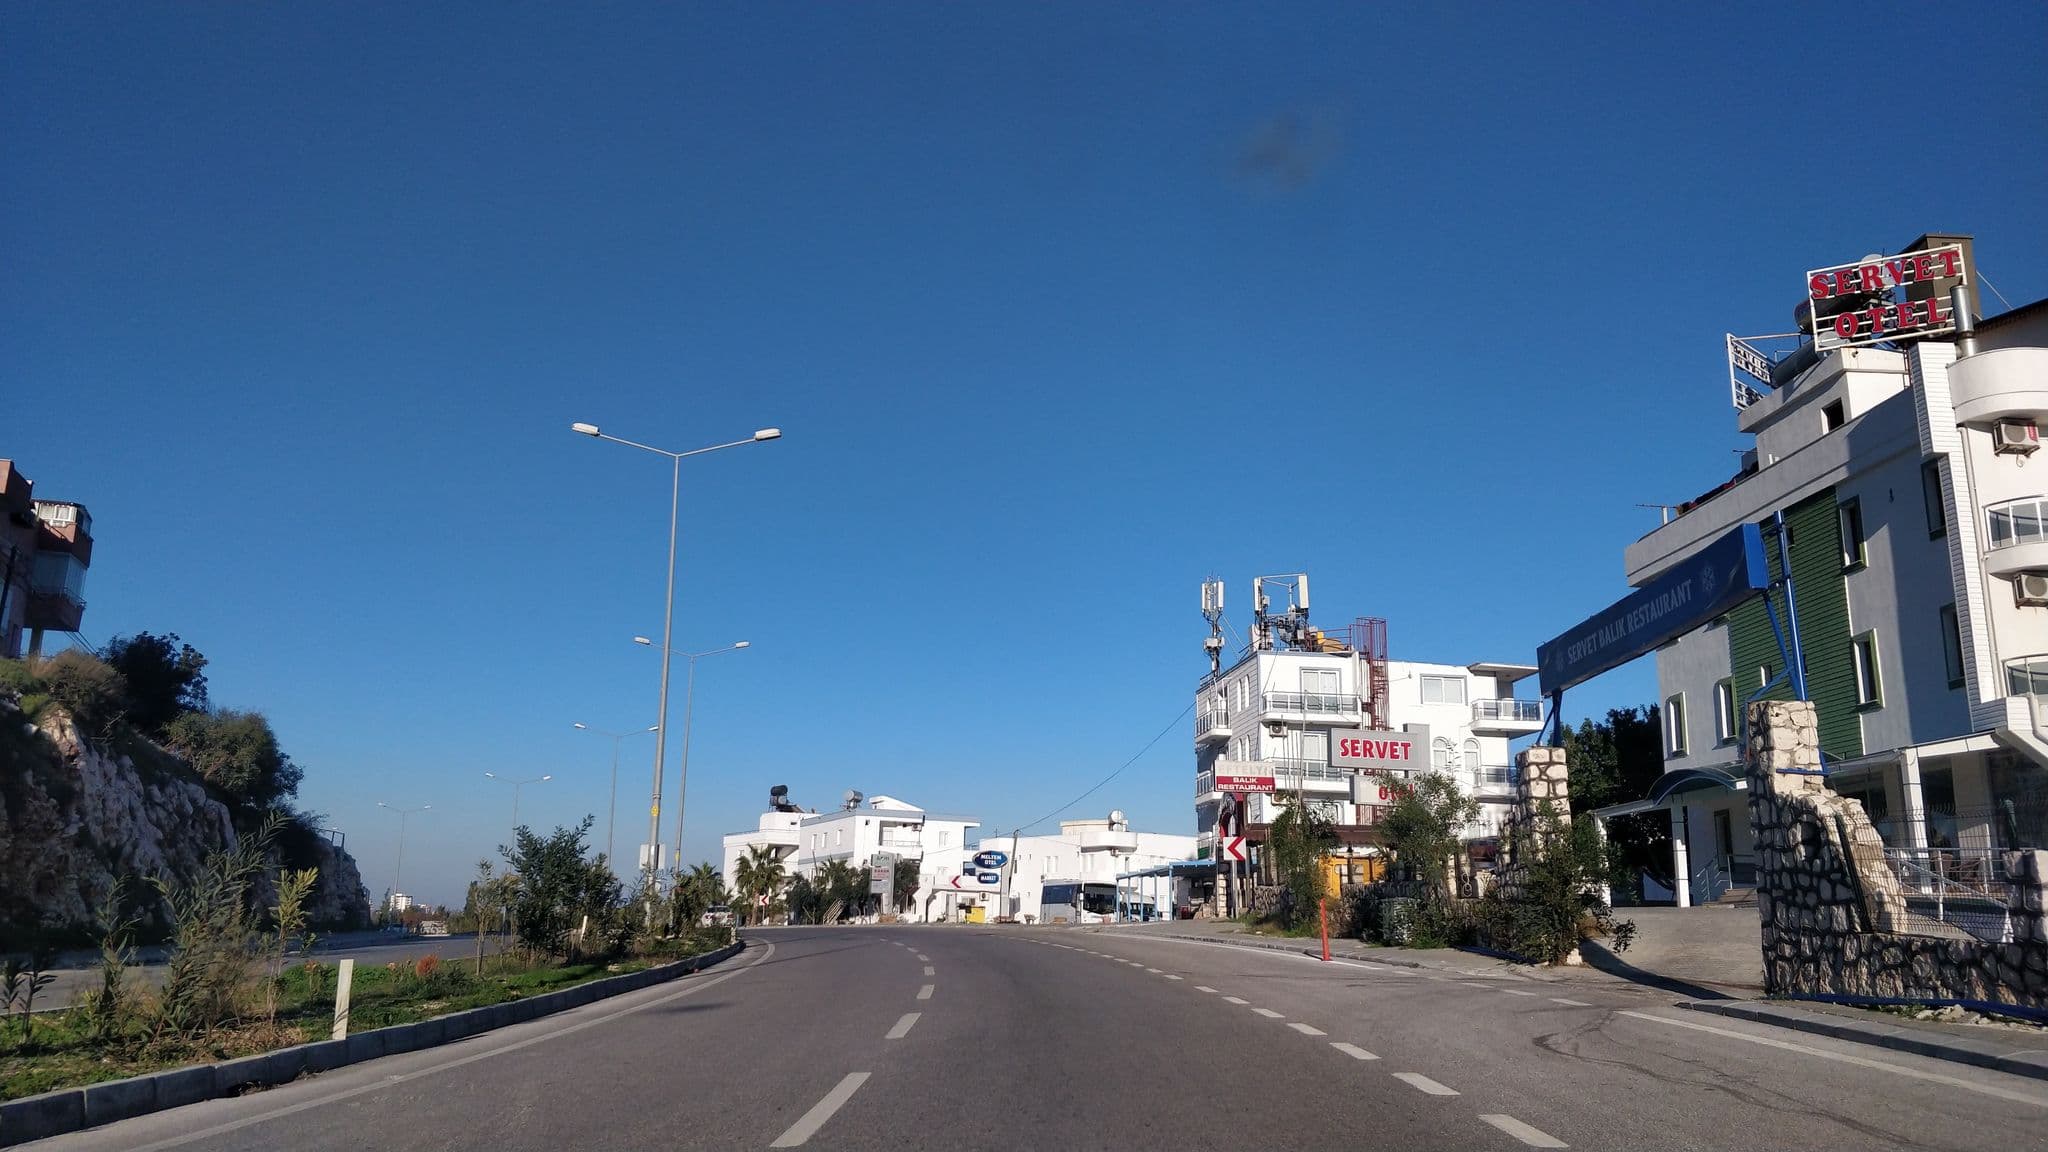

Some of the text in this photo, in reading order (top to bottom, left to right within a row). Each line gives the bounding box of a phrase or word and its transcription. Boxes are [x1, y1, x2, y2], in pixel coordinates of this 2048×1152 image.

[1810, 249, 1961, 300] SERVET
[1834, 297, 1948, 339] OTEL
[1567, 579, 1694, 665] SERVET BALIK RESTAURANT
[1339, 738, 1413, 761] SERVET
[1217, 783, 1273, 791] RESTAURANT
